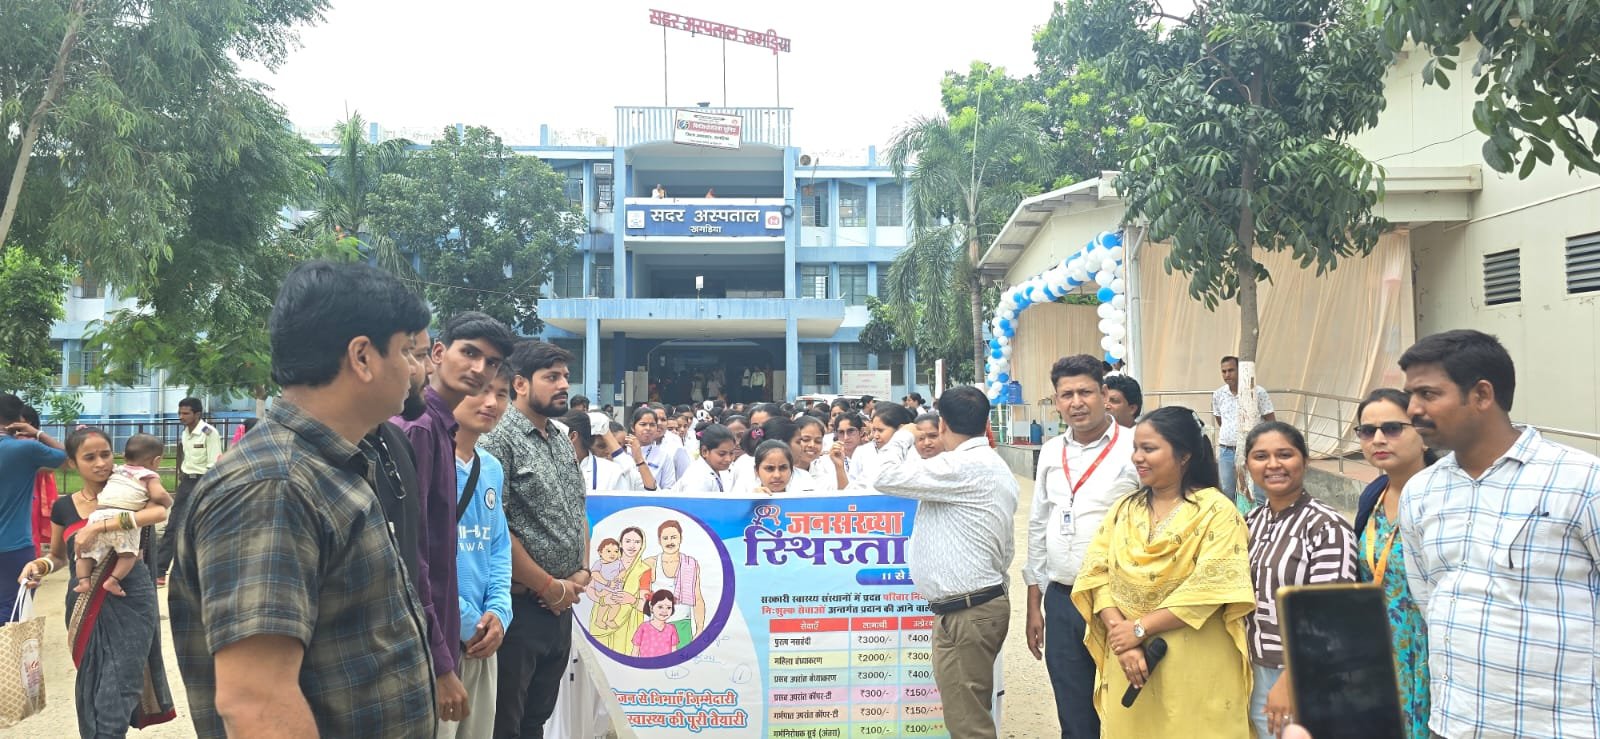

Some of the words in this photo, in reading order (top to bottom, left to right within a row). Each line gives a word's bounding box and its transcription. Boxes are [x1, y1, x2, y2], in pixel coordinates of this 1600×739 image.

[651, 209, 685, 222] सदर
[694, 209, 760, 222] अस्पताल
[785, 505, 904, 535] जनसंख्या
[744, 525, 909, 566] स्थिरता
[895, 570, 905, 580] से
[761, 593, 790, 603] सरकारी
[792, 595, 819, 603] स्वास्थ्य
[822, 592, 851, 602] संस्थानों
[854, 592, 862, 602] में
[882, 592, 909, 601] परिवार
[797, 604, 826, 614] सेवाओं
[860, 605, 882, 613] प्रदान
[884, 604, 894, 612] की
[897, 603, 914, 612] जाने
[858, 634, 892, 644] ₹3000/-
[774, 656, 793, 665] महिला
[858, 653, 892, 663] ₹2000/-
[858, 671, 892, 681] ₹3000/-
[638, 691, 647, 703] से
[860, 689, 889, 698] ₹300/-
[860, 707, 889, 717] ₹300/-
[627, 713, 664, 726] स्वास्थ्य
[669, 711, 684, 726] की
[688, 711, 707, 730] पूरी
[710, 710, 746, 726] तैयारी
[860, 726, 889, 735] ₹100/-
